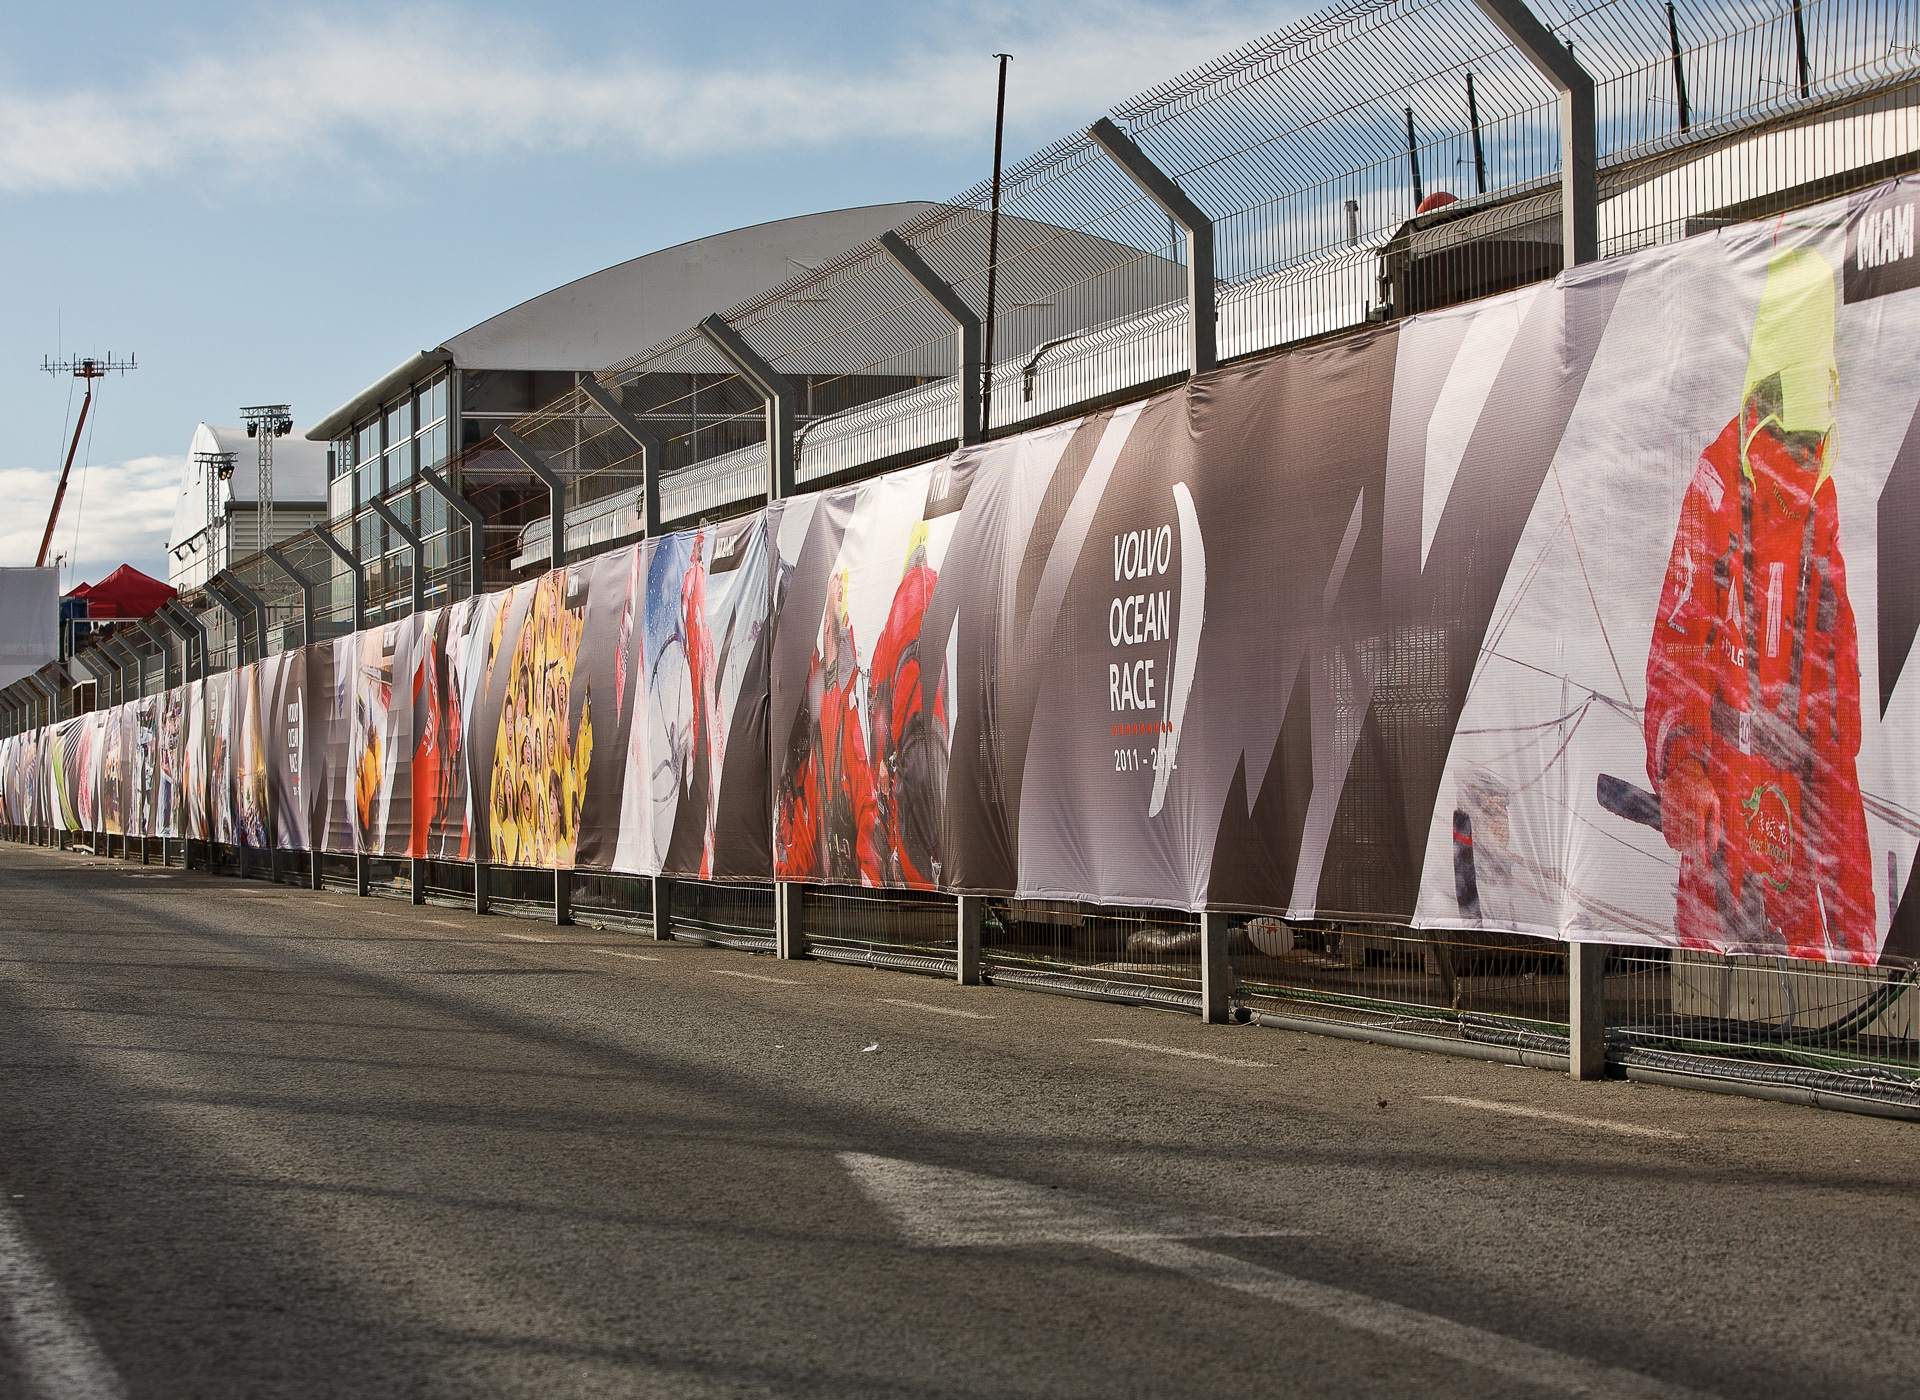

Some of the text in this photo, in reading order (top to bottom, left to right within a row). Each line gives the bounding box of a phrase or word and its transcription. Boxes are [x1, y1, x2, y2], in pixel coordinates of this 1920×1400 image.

[1857, 203, 1915, 271] MIAMI
[1114, 524, 1171, 581] VOLVO
[1109, 590, 1171, 647] OCEAN
[1109, 660, 1156, 711] RACE
[1114, 749, 1139, 771] 2011
